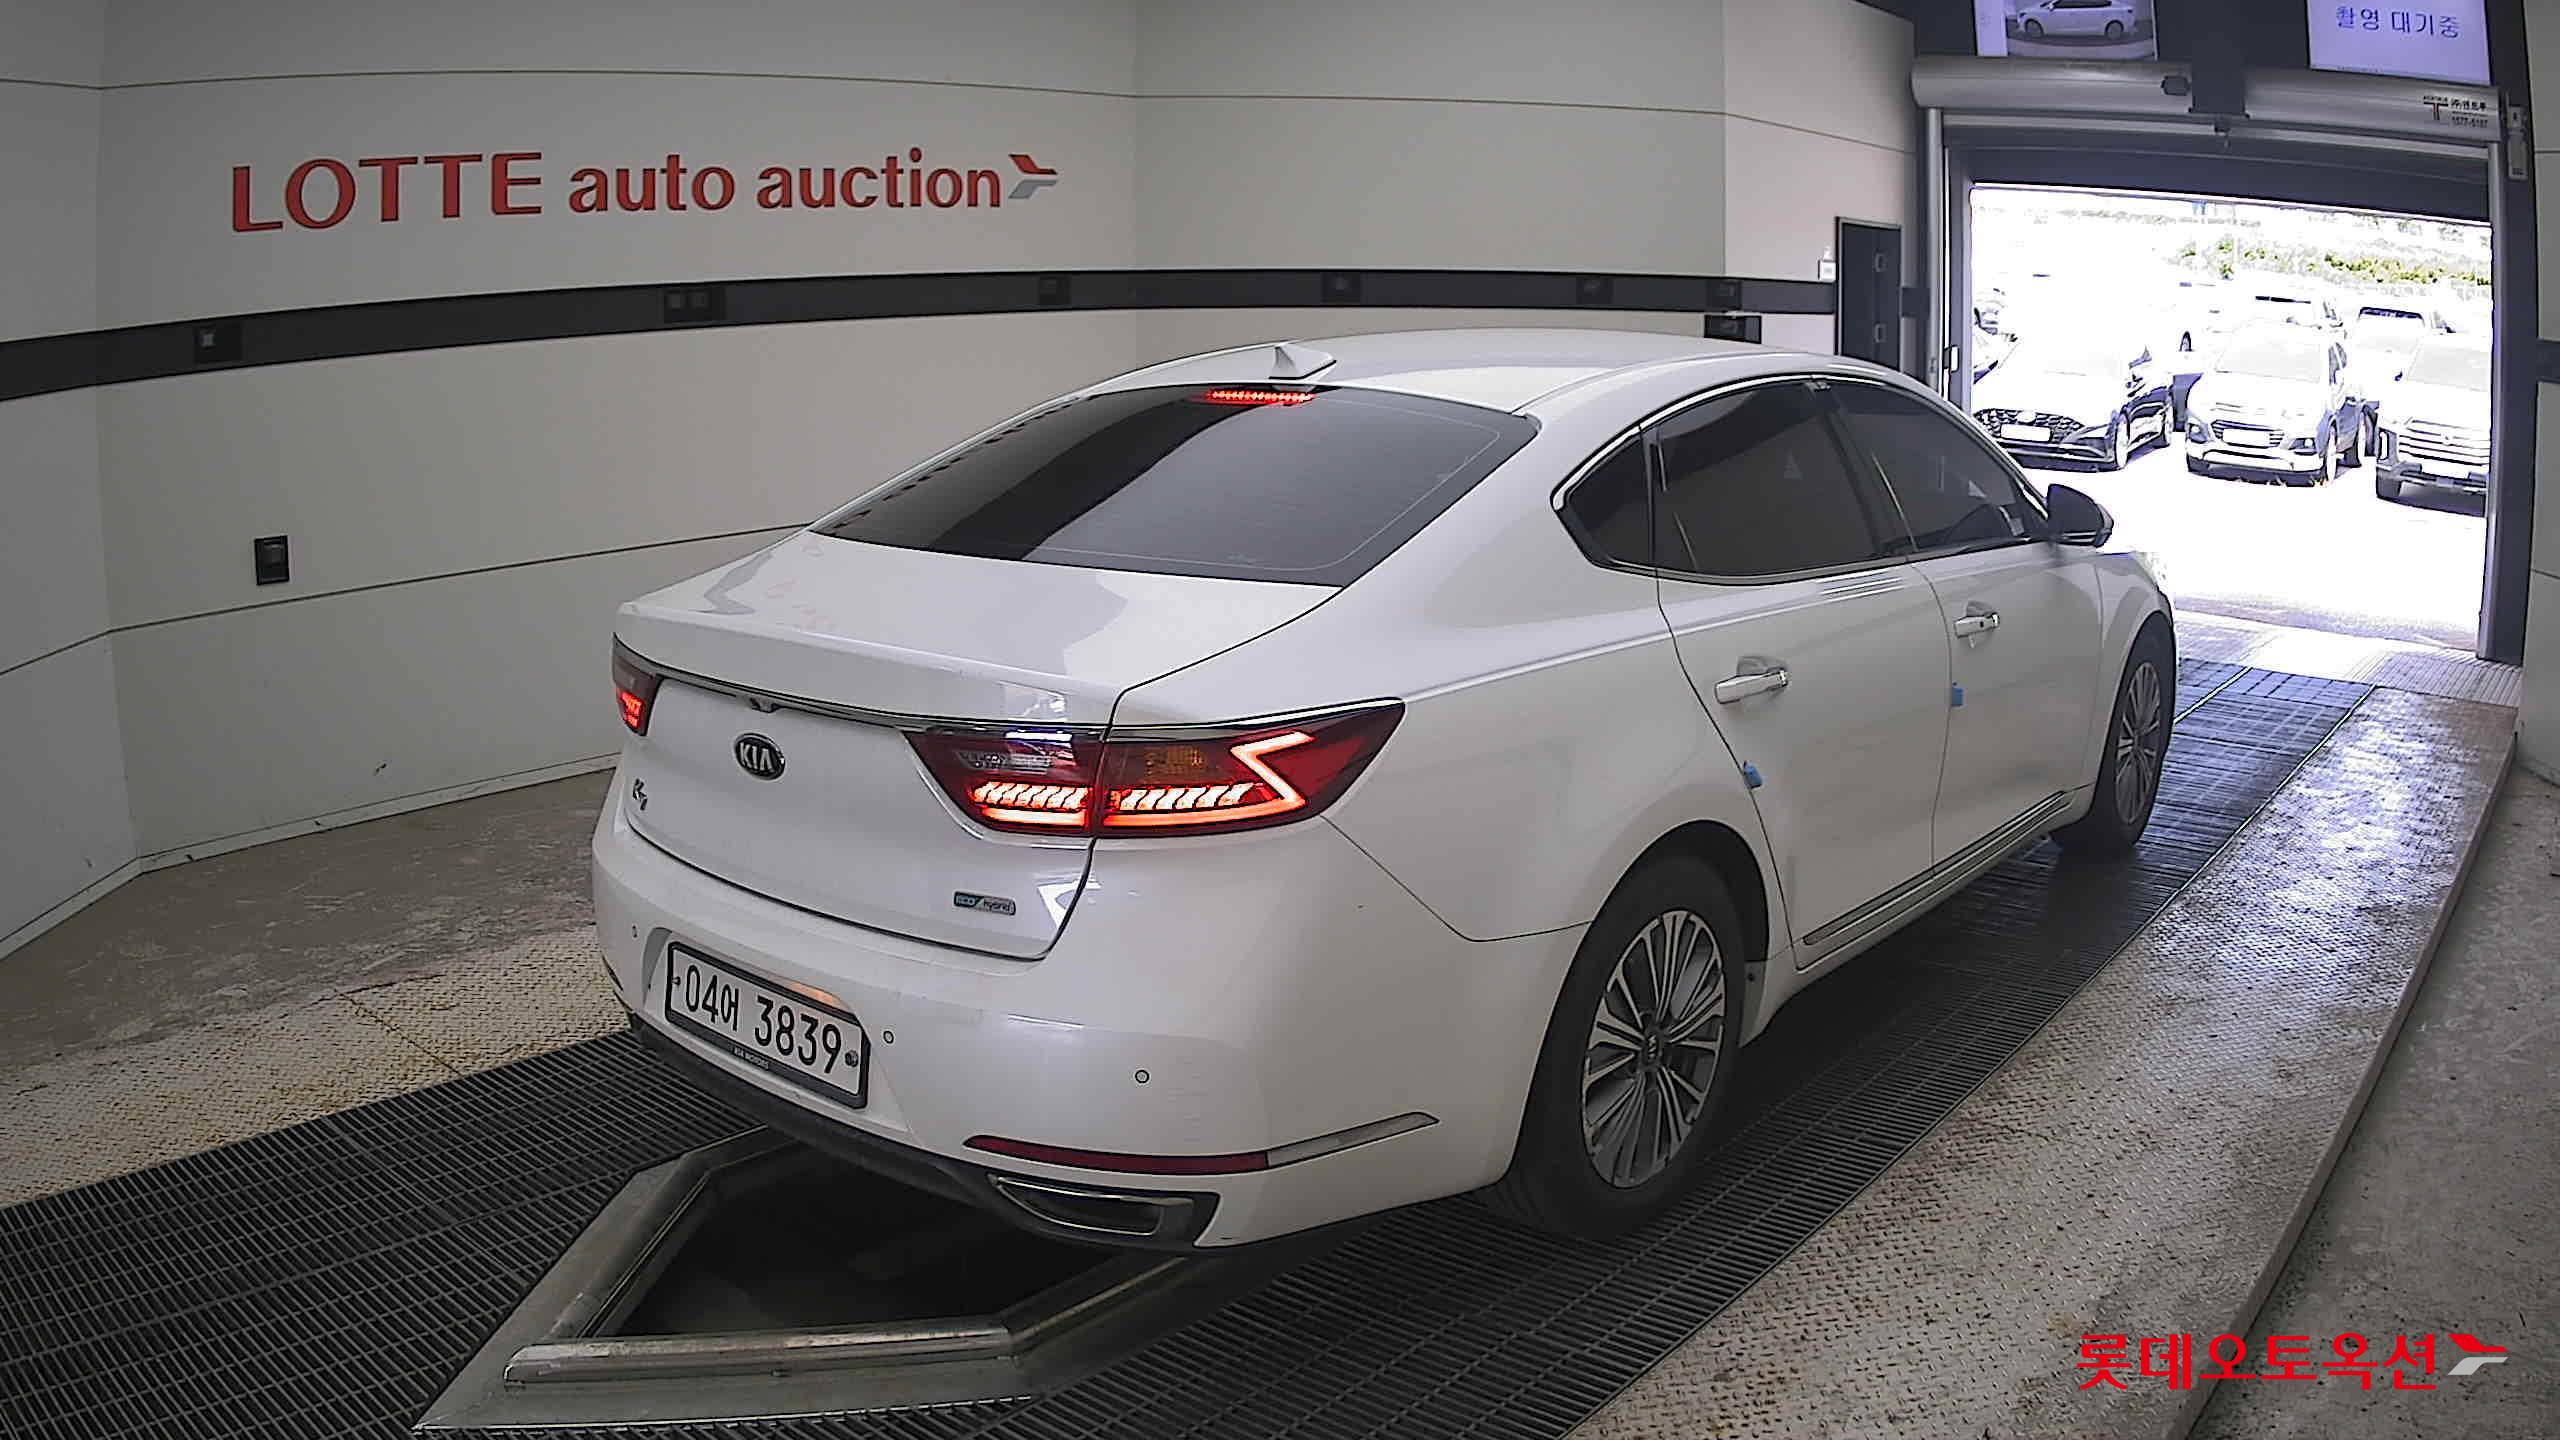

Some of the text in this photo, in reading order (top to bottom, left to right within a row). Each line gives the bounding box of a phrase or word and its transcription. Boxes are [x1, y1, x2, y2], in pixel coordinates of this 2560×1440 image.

[2391, 11, 2460, 39] 대기중
[232, 147, 1002, 233] LOTTE auto auction
[738, 742, 774, 772] KIA
[686, 965, 842, 1074] 04어 3839
